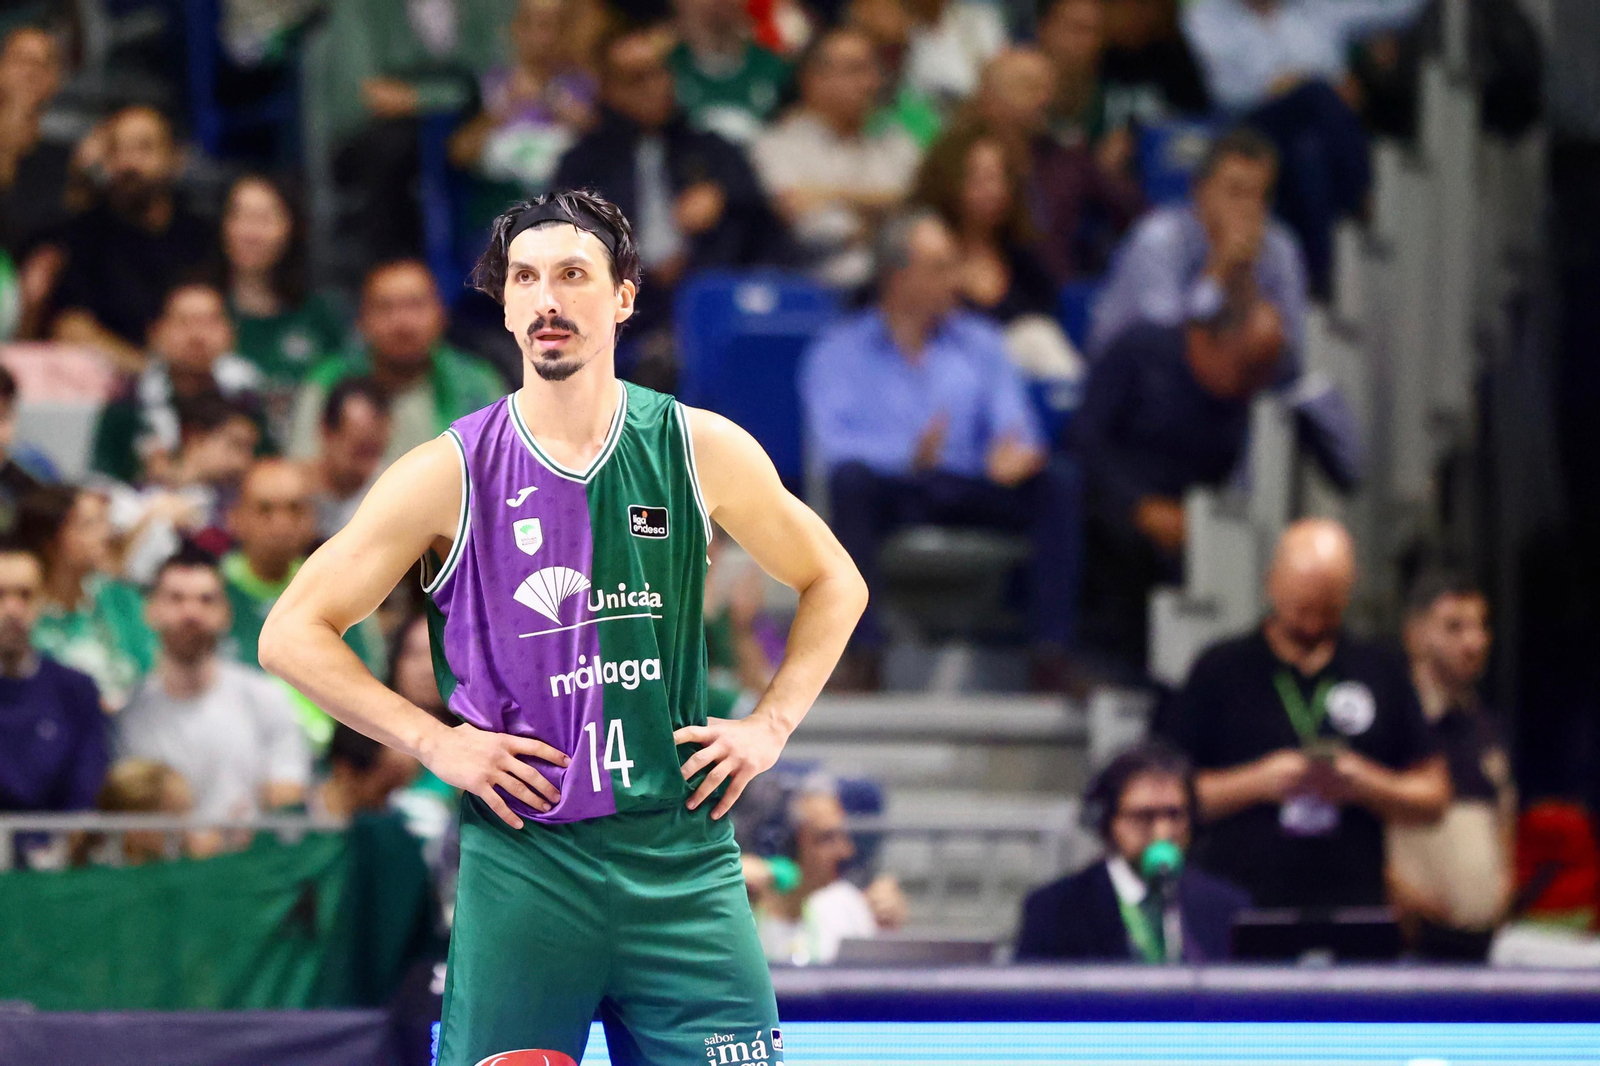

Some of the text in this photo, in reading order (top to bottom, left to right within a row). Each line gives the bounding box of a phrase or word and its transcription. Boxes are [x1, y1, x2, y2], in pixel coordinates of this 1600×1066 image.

[632, 514, 647, 525] liga
[633, 524, 665, 534] endesa
[587, 582, 663, 612] Unicaa
[584, 719, 634, 792] 14
[704, 1032, 735, 1046] sabor
[706, 1046, 716, 1057] a
[716, 1030, 769, 1065] má
